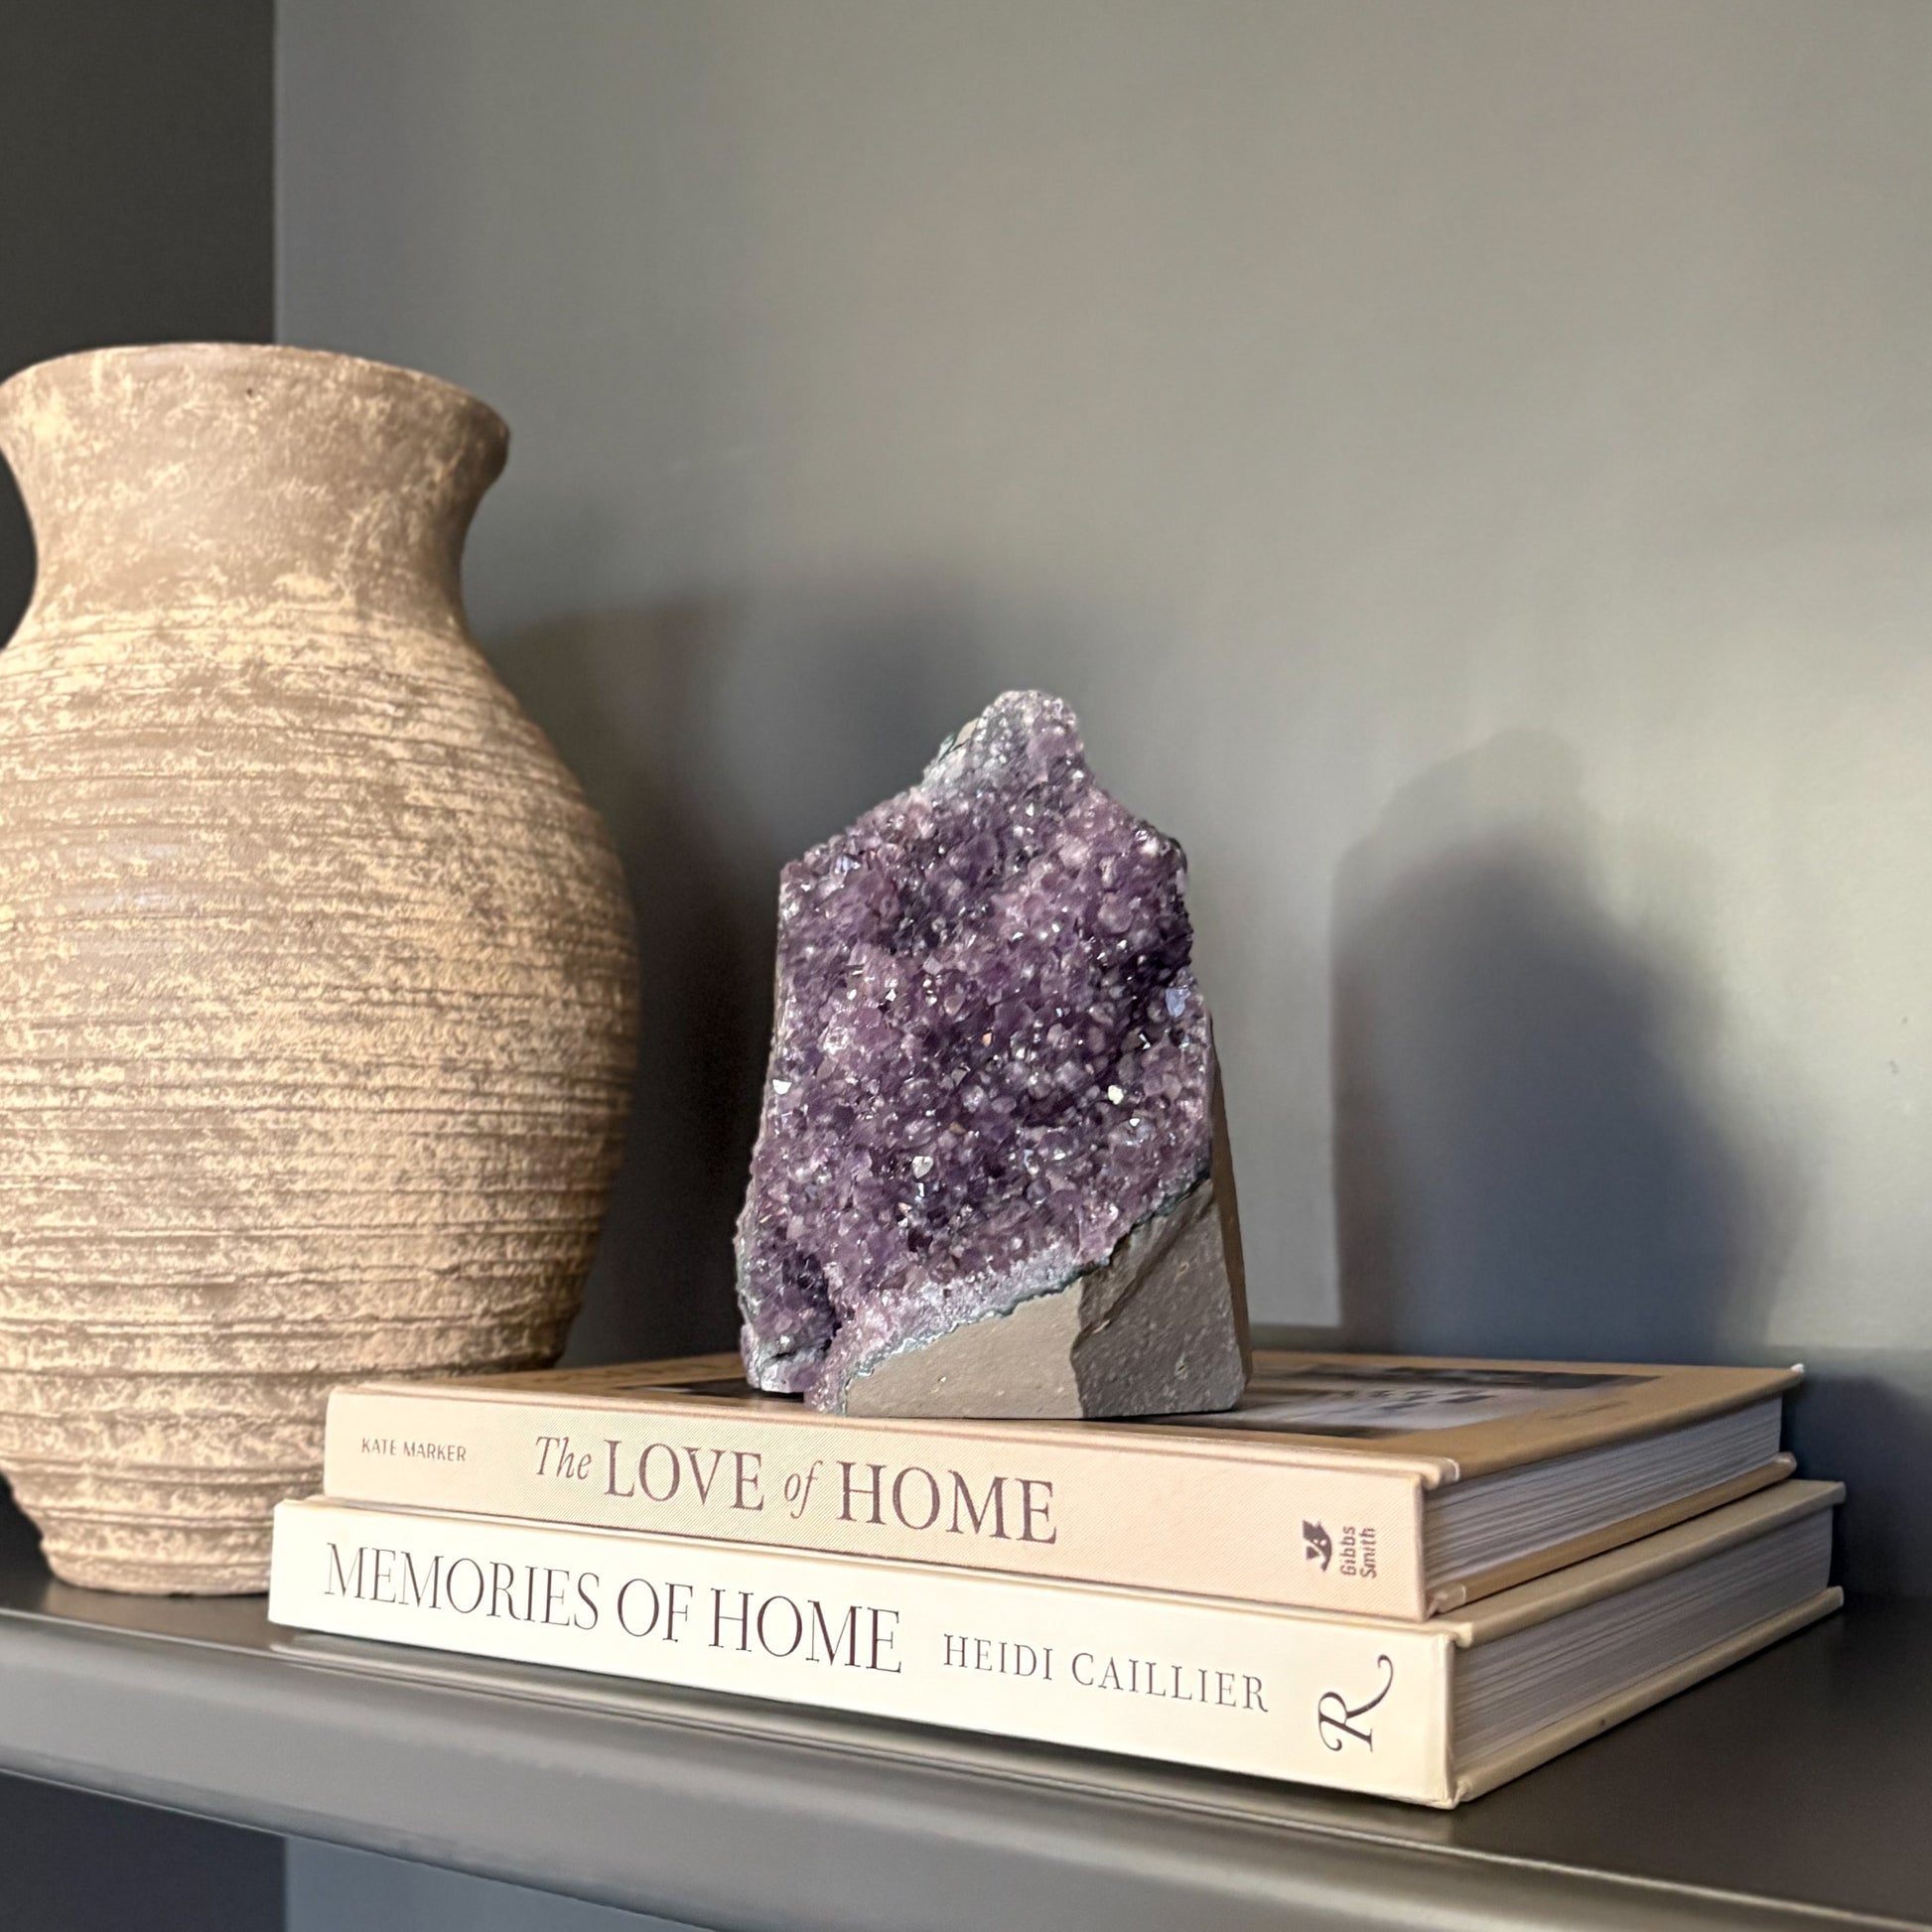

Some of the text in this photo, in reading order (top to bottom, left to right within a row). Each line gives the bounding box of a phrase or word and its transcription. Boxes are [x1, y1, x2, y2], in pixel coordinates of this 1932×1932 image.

[361, 1438, 468, 1462] KATE MARKER
[535, 1435, 1057, 1545] The LOVE of HOME
[1339, 1526, 1358, 1577] Gibbs
[1359, 1526, 1378, 1580] Smith
[324, 1542, 901, 1674] MEMORIES OF HOME
[944, 1633, 1269, 1714] HEIDI CAILLIER
